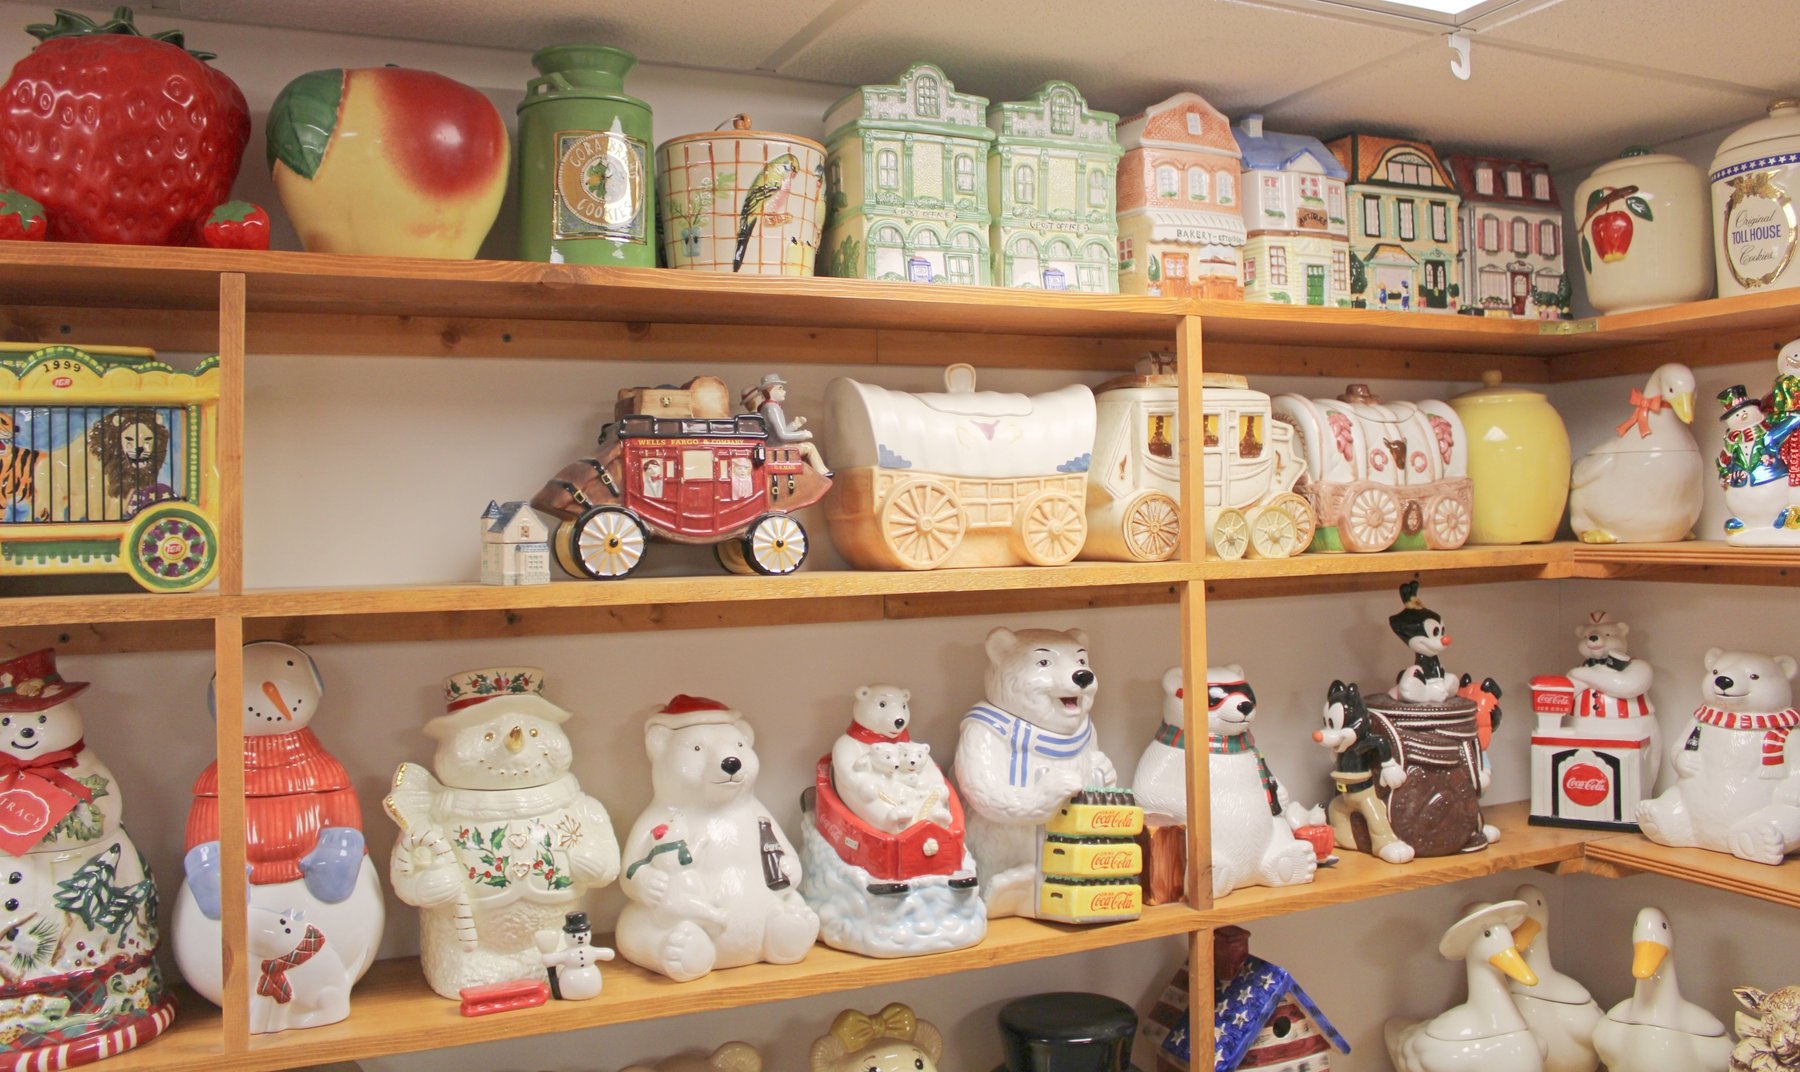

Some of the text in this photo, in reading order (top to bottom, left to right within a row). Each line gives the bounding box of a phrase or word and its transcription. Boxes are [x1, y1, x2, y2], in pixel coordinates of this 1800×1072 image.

[570, 138, 602, 168] CORA
[1035, 220, 1054, 230] POST
[1735, 209, 1777, 228] Original
[1732, 224, 1782, 245] TOLL HOUSE
[1740, 244, 1773, 265] Cookies
[42, 359, 81, 373] 1999
[54, 378, 71, 387] IGA
[1566, 777, 1607, 791] Coca-Cola
[0, 797, 42, 827] TRACY
